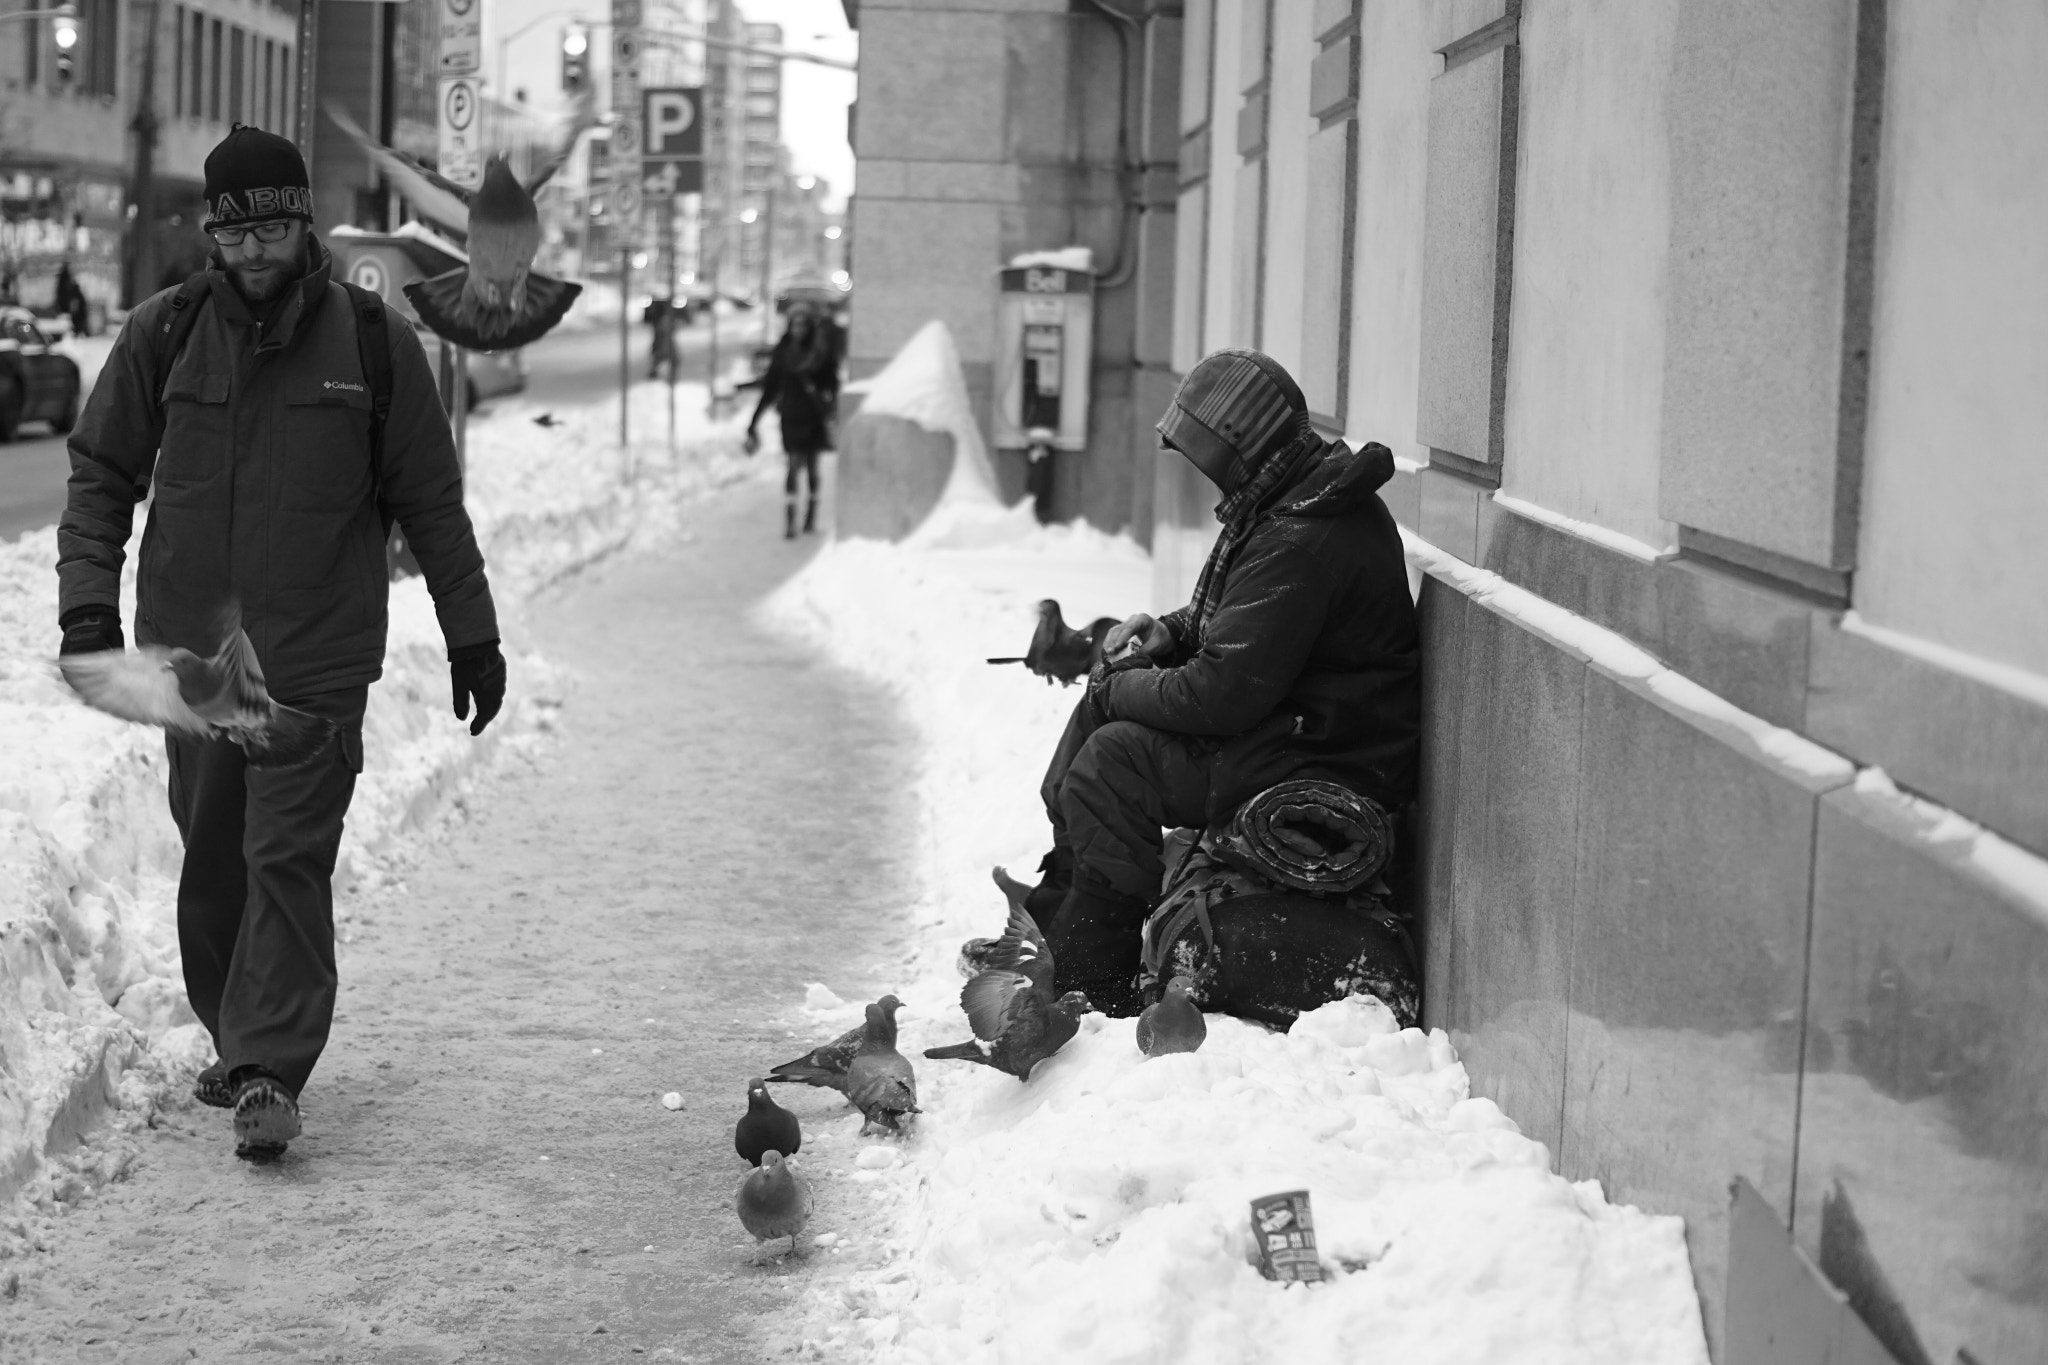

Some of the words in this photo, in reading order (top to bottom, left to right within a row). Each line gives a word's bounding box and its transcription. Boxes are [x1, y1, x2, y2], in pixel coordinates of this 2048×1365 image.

[647, 93, 695, 153] P
[205, 186, 315, 222] ABON
[359, 266, 381, 291] P
[331, 381, 364, 392] Columbia
